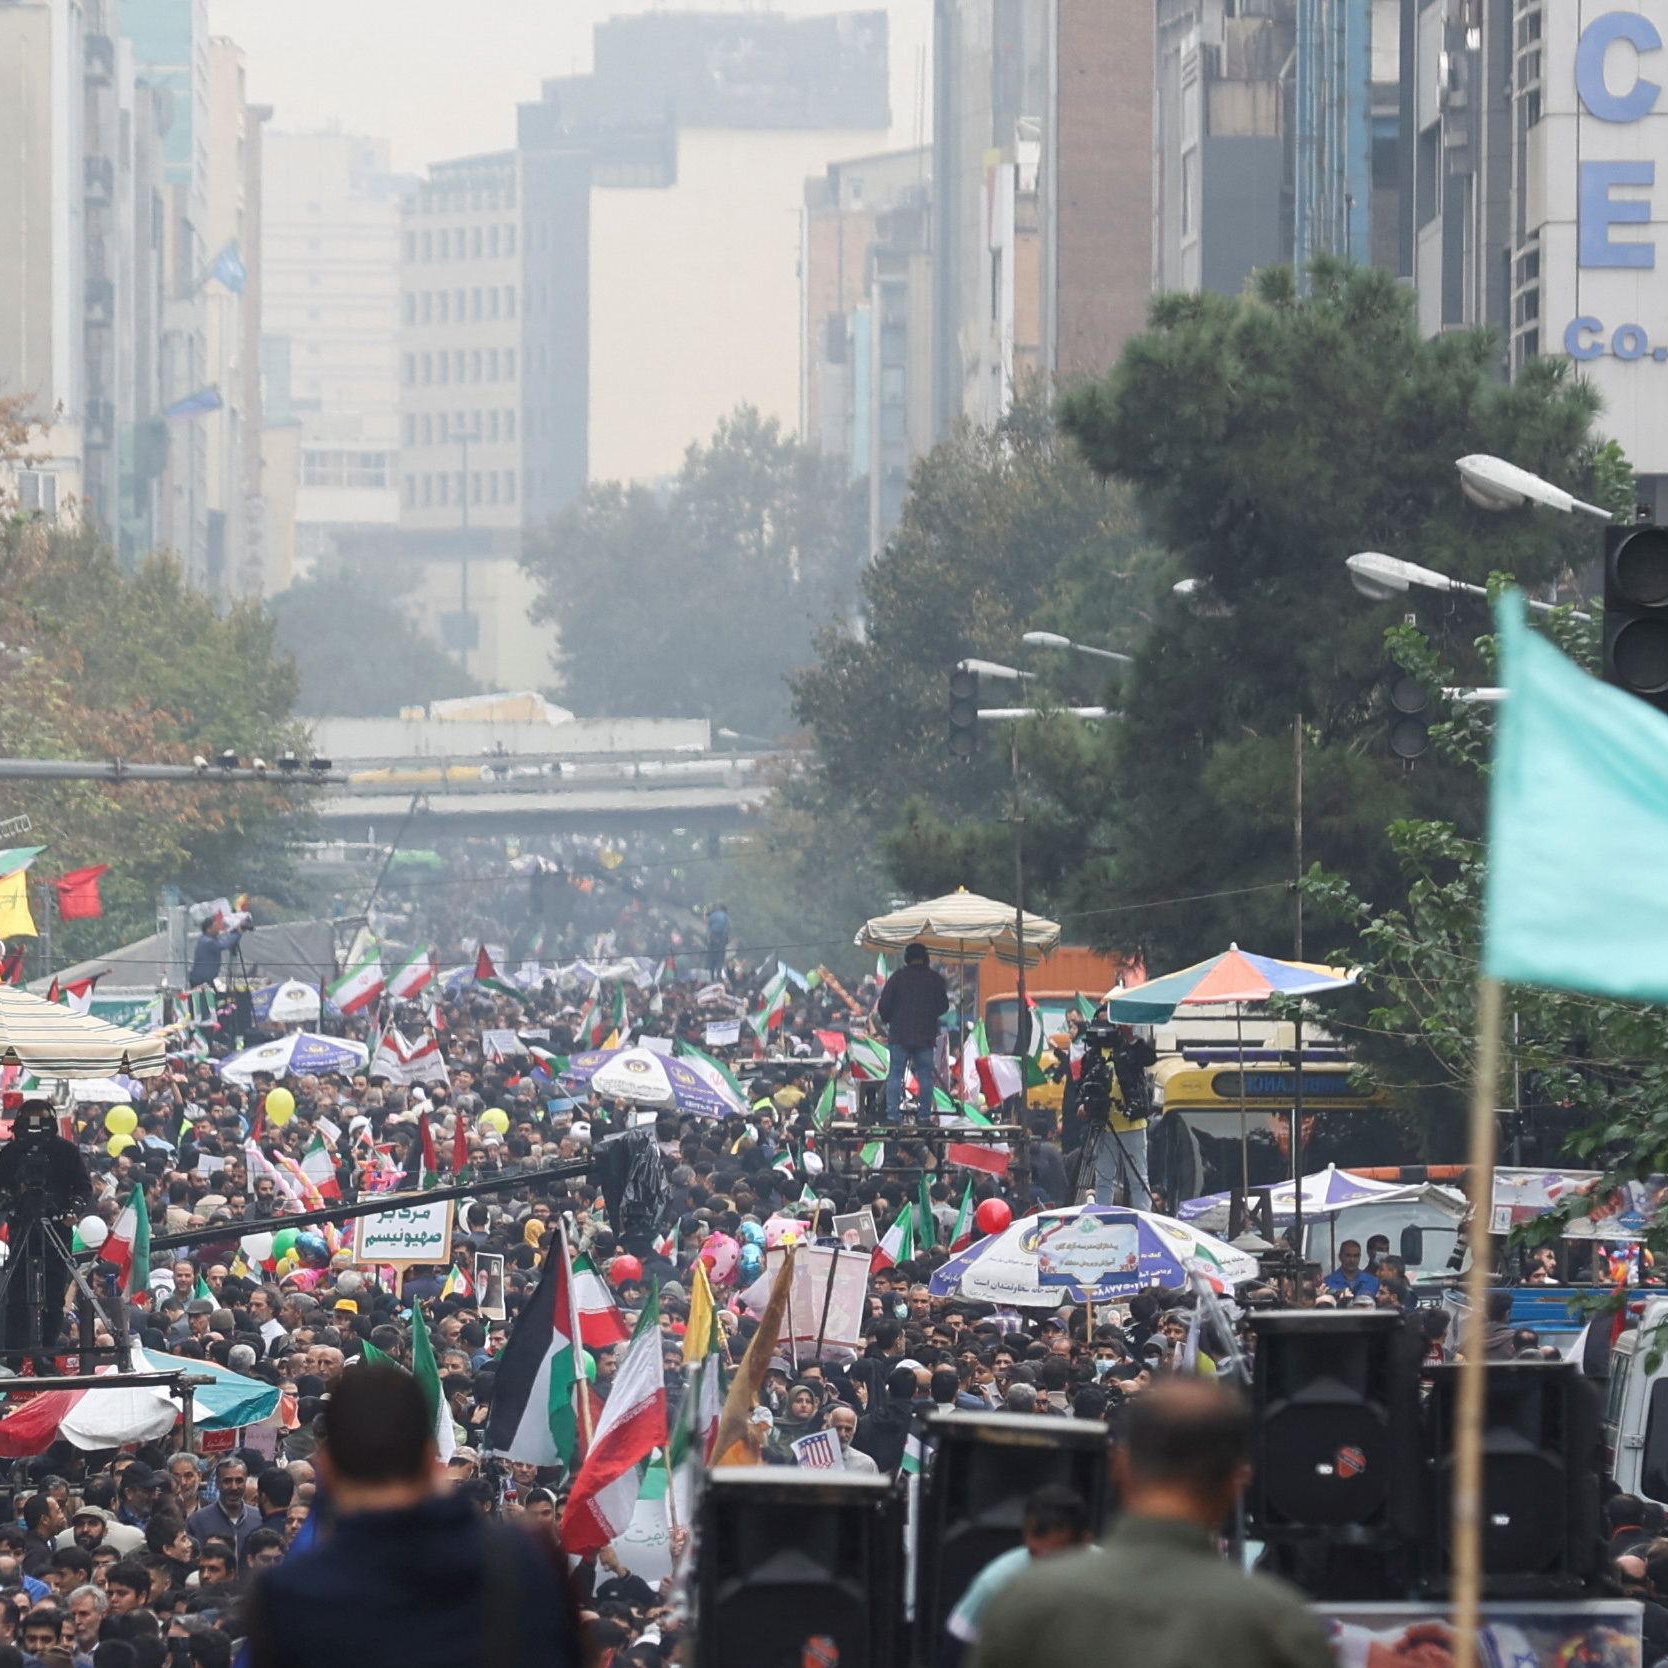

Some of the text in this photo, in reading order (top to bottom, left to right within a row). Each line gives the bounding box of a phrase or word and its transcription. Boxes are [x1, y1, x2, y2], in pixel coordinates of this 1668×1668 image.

[1564, 317, 1668, 361] Co.
[365, 1228, 442, 1248] صهیونیسم
[973, 1278, 990, 1287] است
